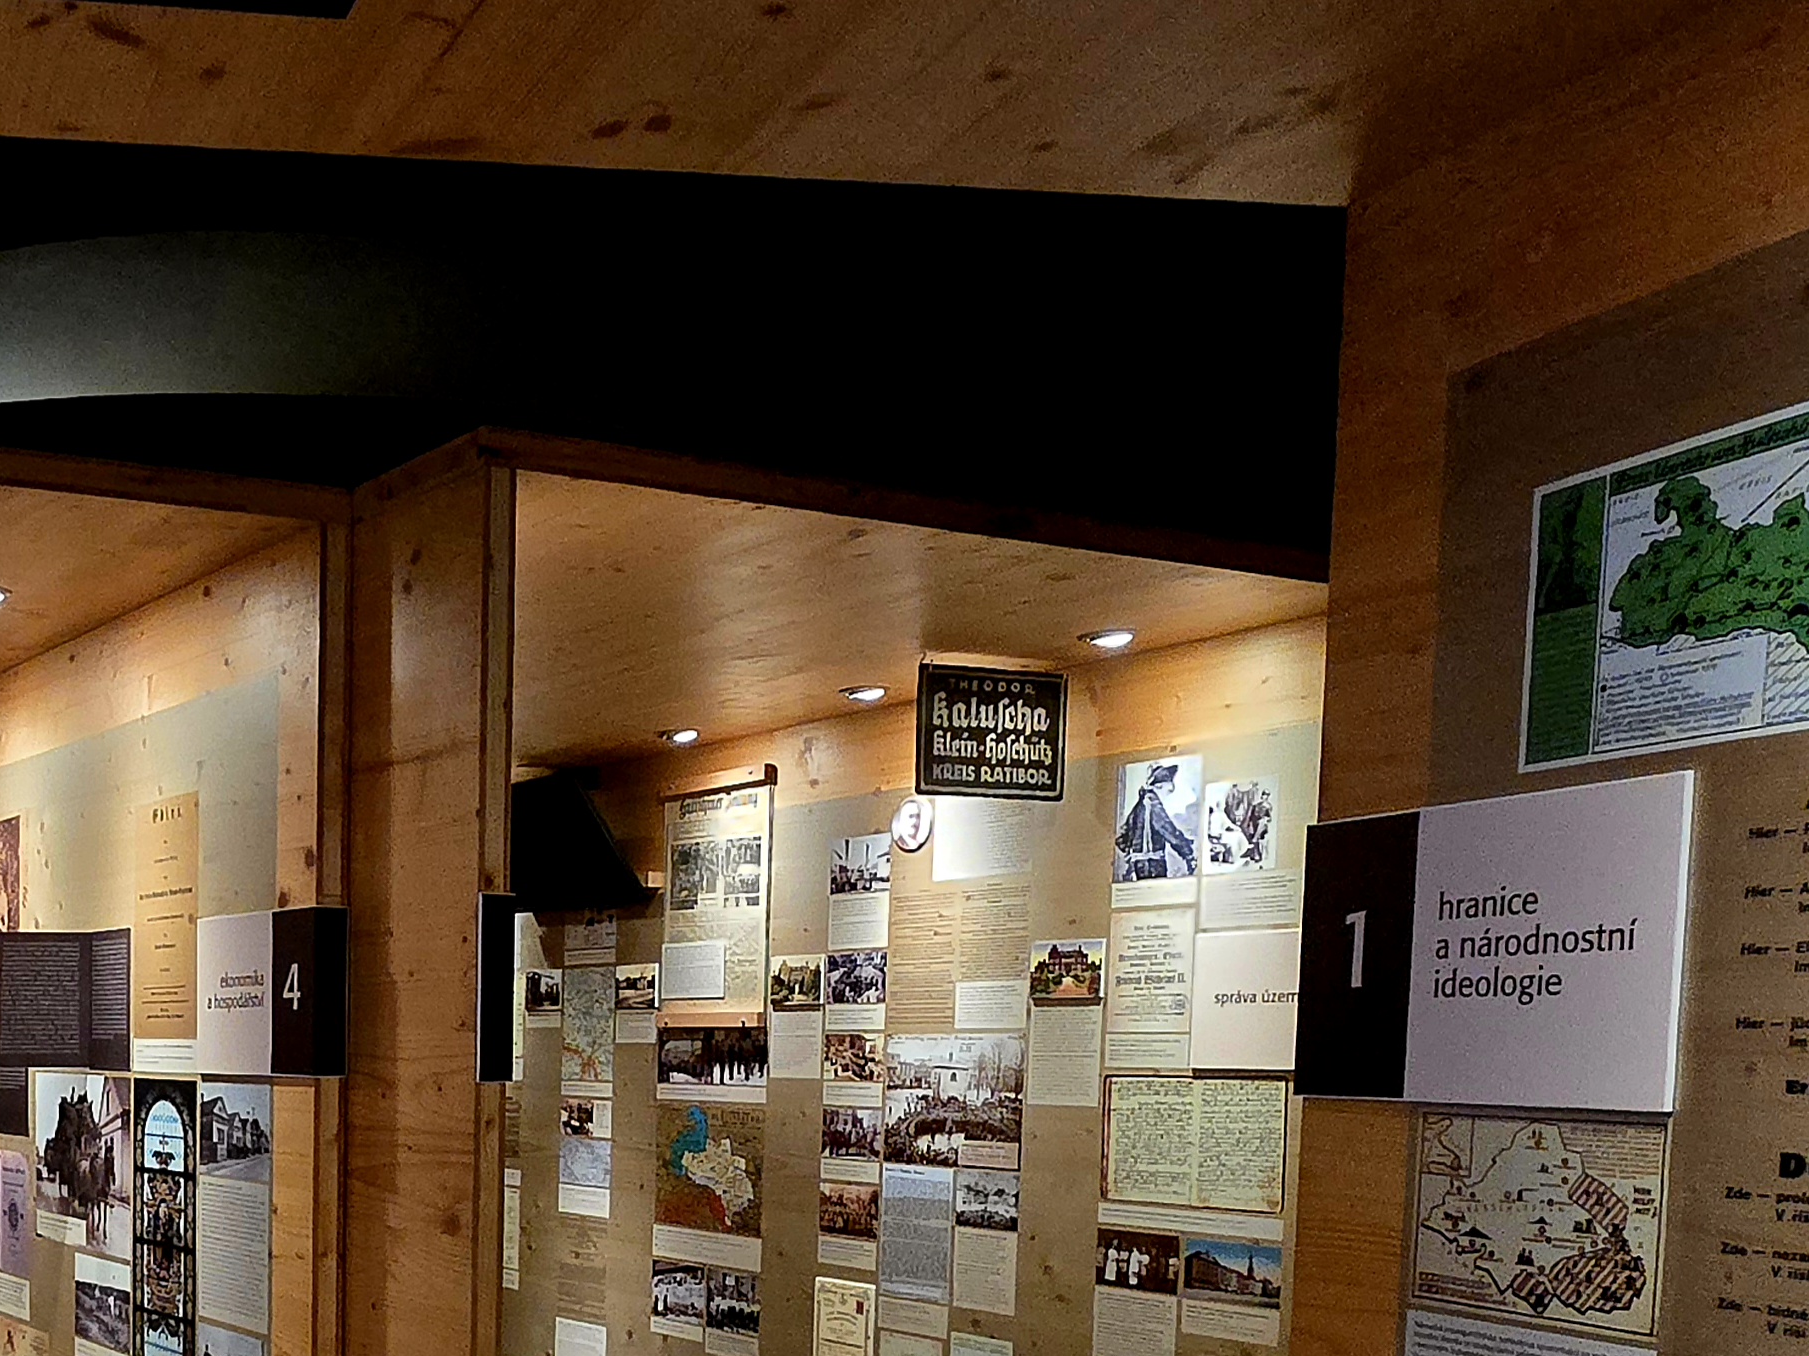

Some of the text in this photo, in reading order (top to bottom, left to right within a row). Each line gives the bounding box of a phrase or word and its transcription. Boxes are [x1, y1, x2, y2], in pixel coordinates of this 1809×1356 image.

[948, 678, 1036, 695] THEODOR
[932, 763, 1052, 786] KREIS RATIBOR
[1437, 886, 1539, 921] hranice
[1345, 909, 1368, 988] 1
[1435, 918, 1638, 960] a národnostní
[283, 963, 301, 1010] 4
[1214, 989, 1257, 1007] správa
[1432, 965, 1562, 1005] ideologie
